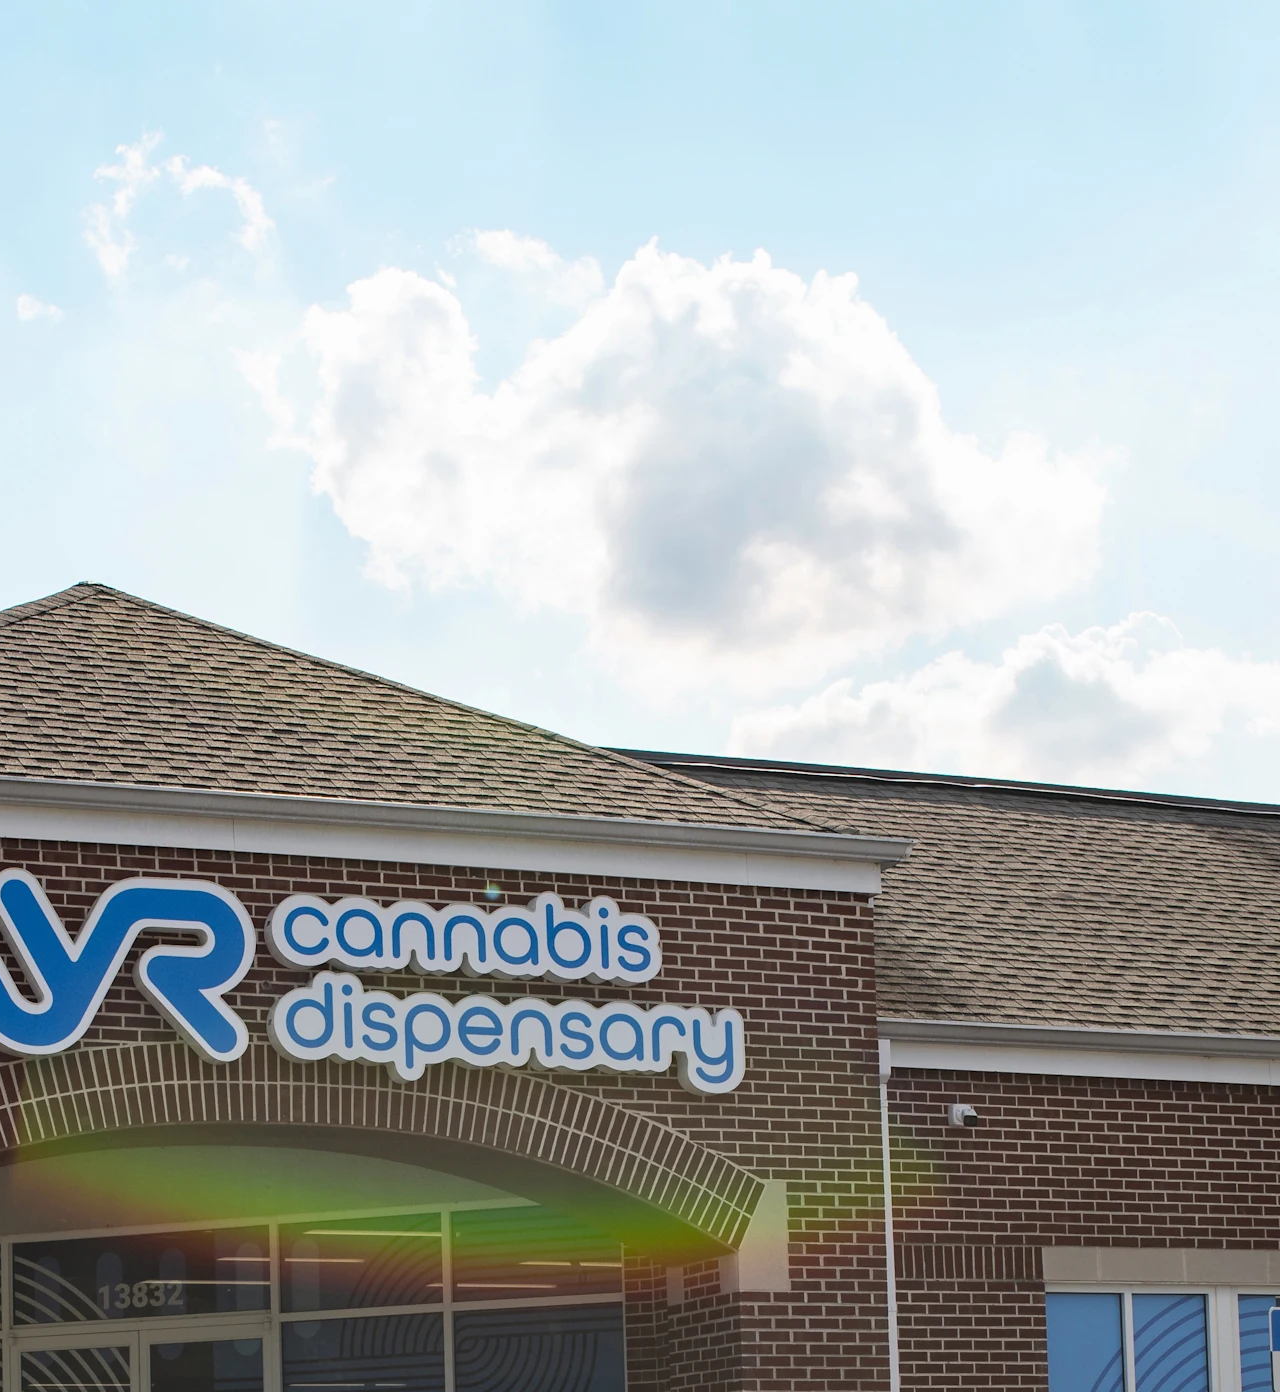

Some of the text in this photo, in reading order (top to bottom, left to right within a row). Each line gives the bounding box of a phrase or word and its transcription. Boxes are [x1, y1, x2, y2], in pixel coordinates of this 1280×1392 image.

[283, 902, 652, 973] cannabis
[284, 981, 735, 1085] dispensary
[98, 1282, 184, 1310] 13832
